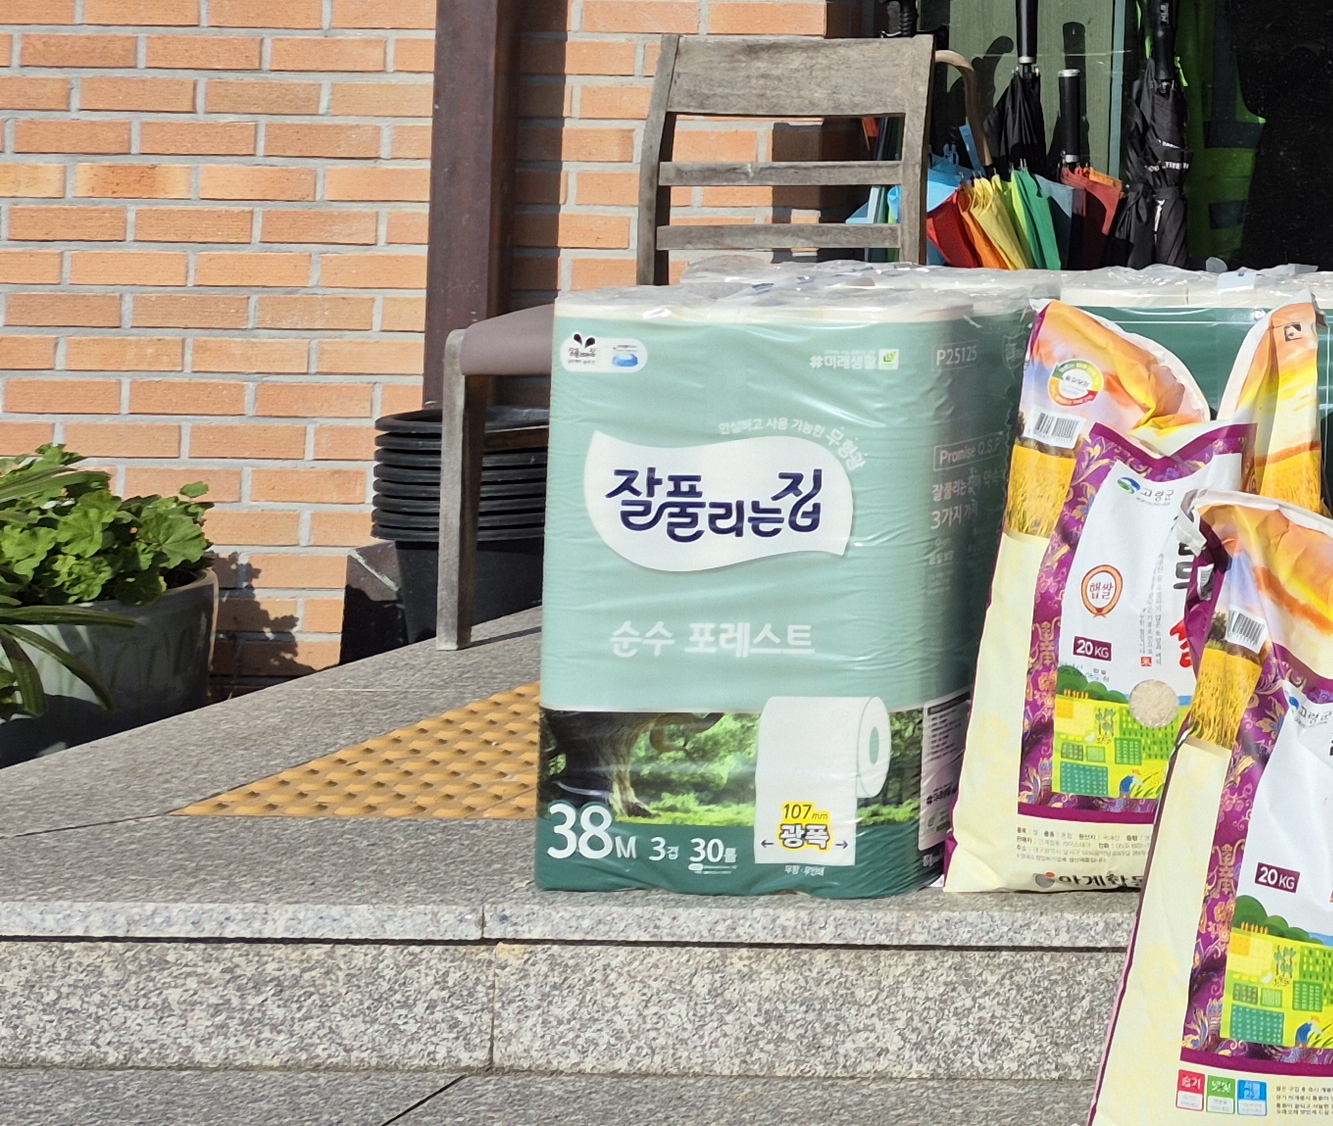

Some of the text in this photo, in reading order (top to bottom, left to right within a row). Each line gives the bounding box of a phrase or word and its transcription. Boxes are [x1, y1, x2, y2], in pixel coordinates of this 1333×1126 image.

[935, 346, 978, 365] P25125
[766, 417, 789, 431] 사용
[940, 446, 976, 465] Promise
[1141, 488, 1175, 502] 고령군
[604, 467, 823, 543] 잘풀리는집
[608, 620, 816, 658] 순수 포레스트
[1298, 705, 1333, 724] 고령군
[779, 823, 830, 850] 광폭
